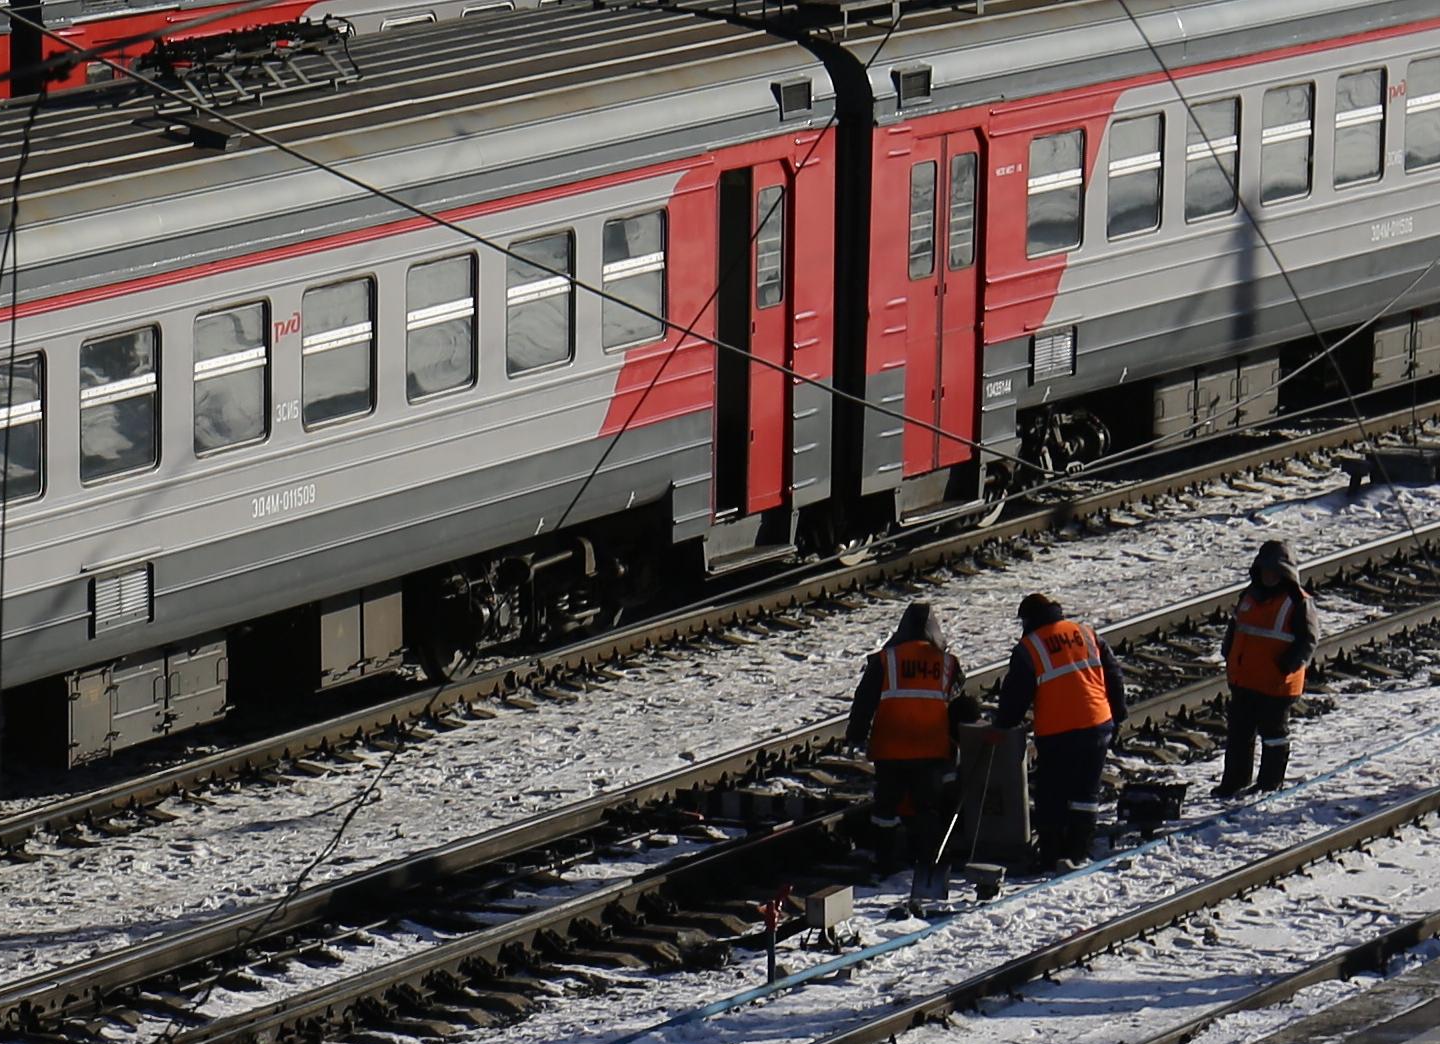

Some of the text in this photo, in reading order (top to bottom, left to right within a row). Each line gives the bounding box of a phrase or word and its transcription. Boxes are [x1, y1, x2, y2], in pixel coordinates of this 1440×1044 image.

[251, 483, 317, 519] ЭД4М-011509
[1046, 630, 1084, 654] ШЧ-6
[901, 659, 941, 681] ШЧ-6
